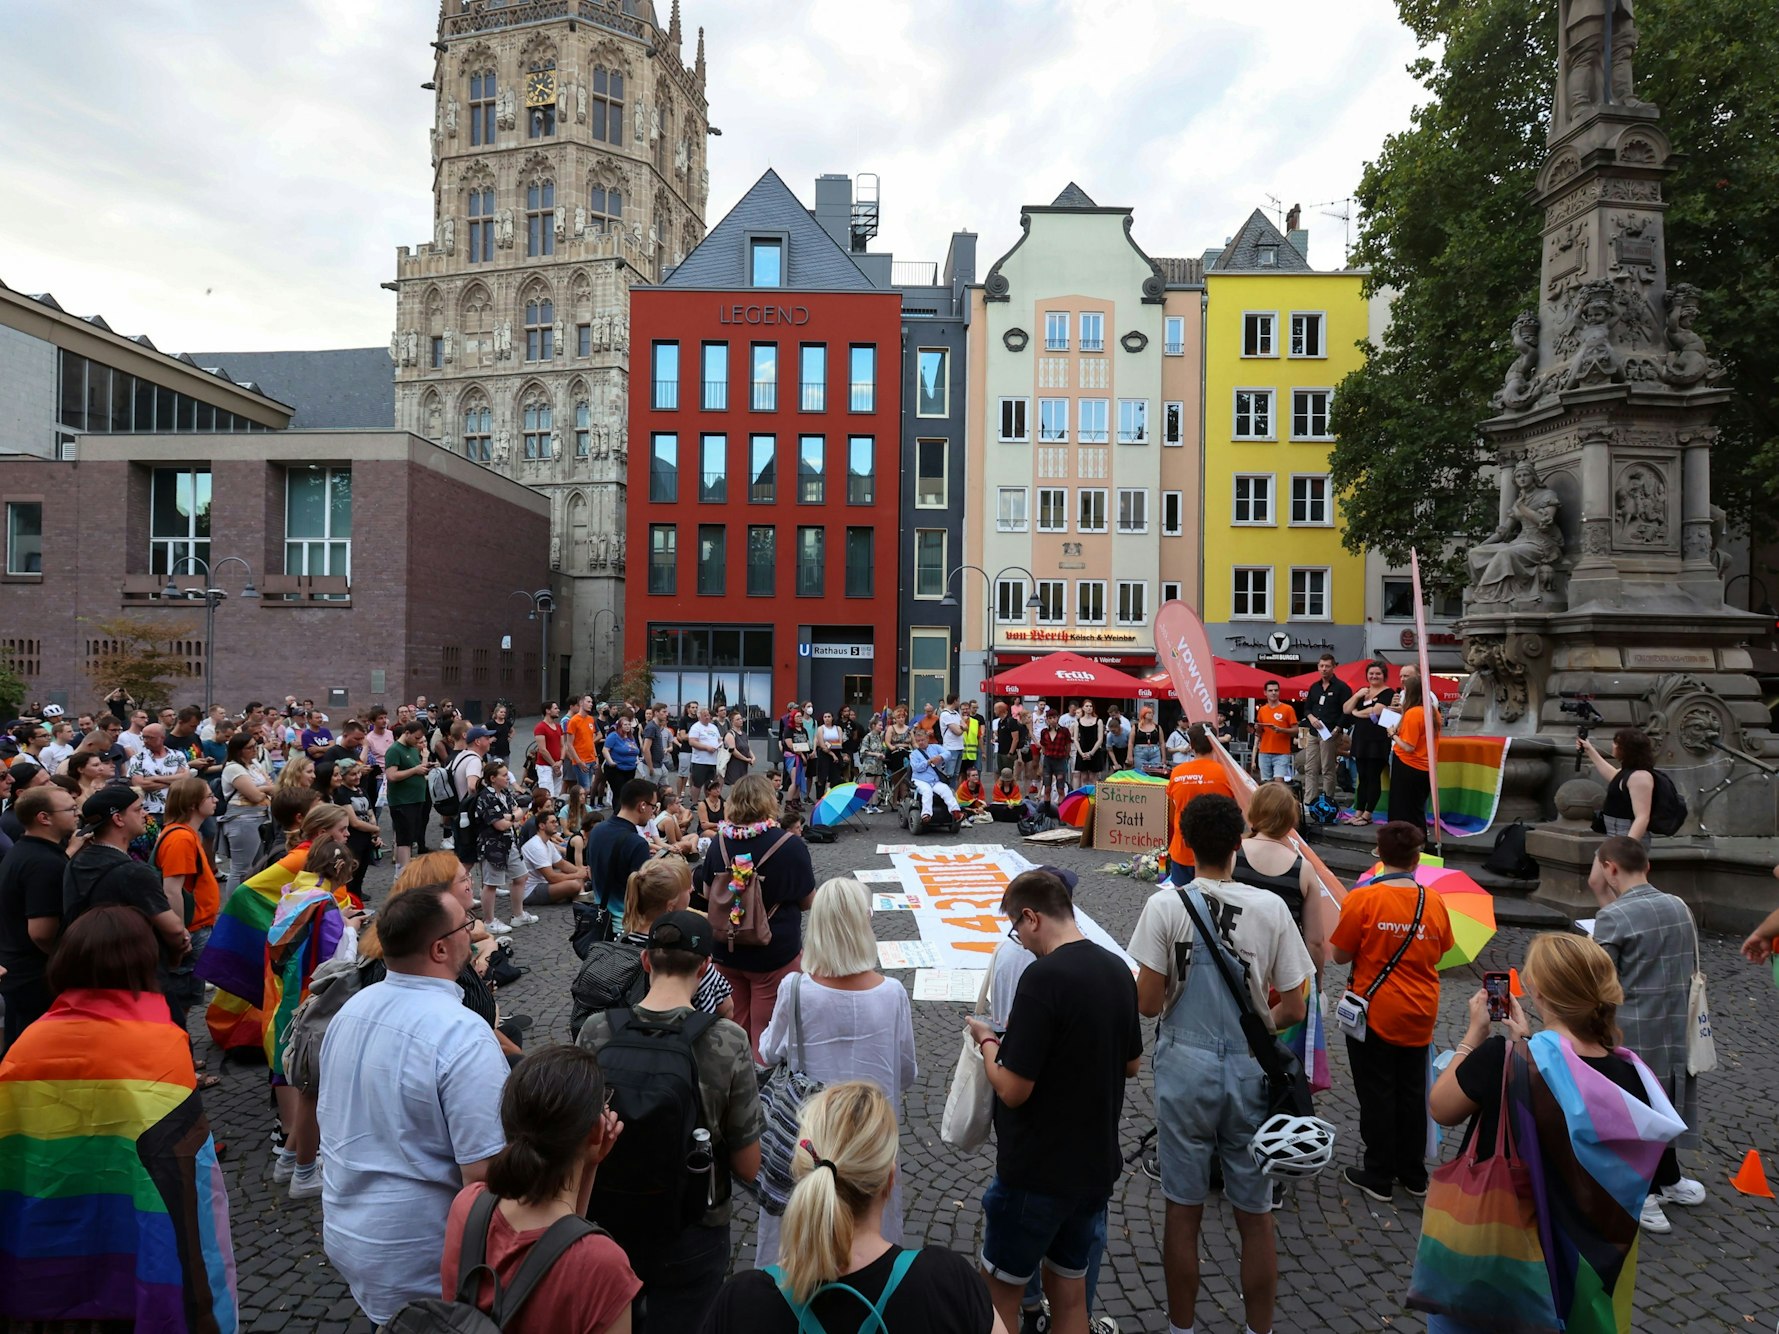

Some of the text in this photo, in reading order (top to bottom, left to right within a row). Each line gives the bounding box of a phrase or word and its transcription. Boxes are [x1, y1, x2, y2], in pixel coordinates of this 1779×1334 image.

[720, 305, 809, 325] LEGEND
[799, 643, 859, 656] U Rathaus 5
[1101, 787, 1147, 805] Stärken
[1115, 811, 1144, 827] Statt
[1109, 829, 1164, 848] Streichen
[1377, 921, 1426, 934] anywy
